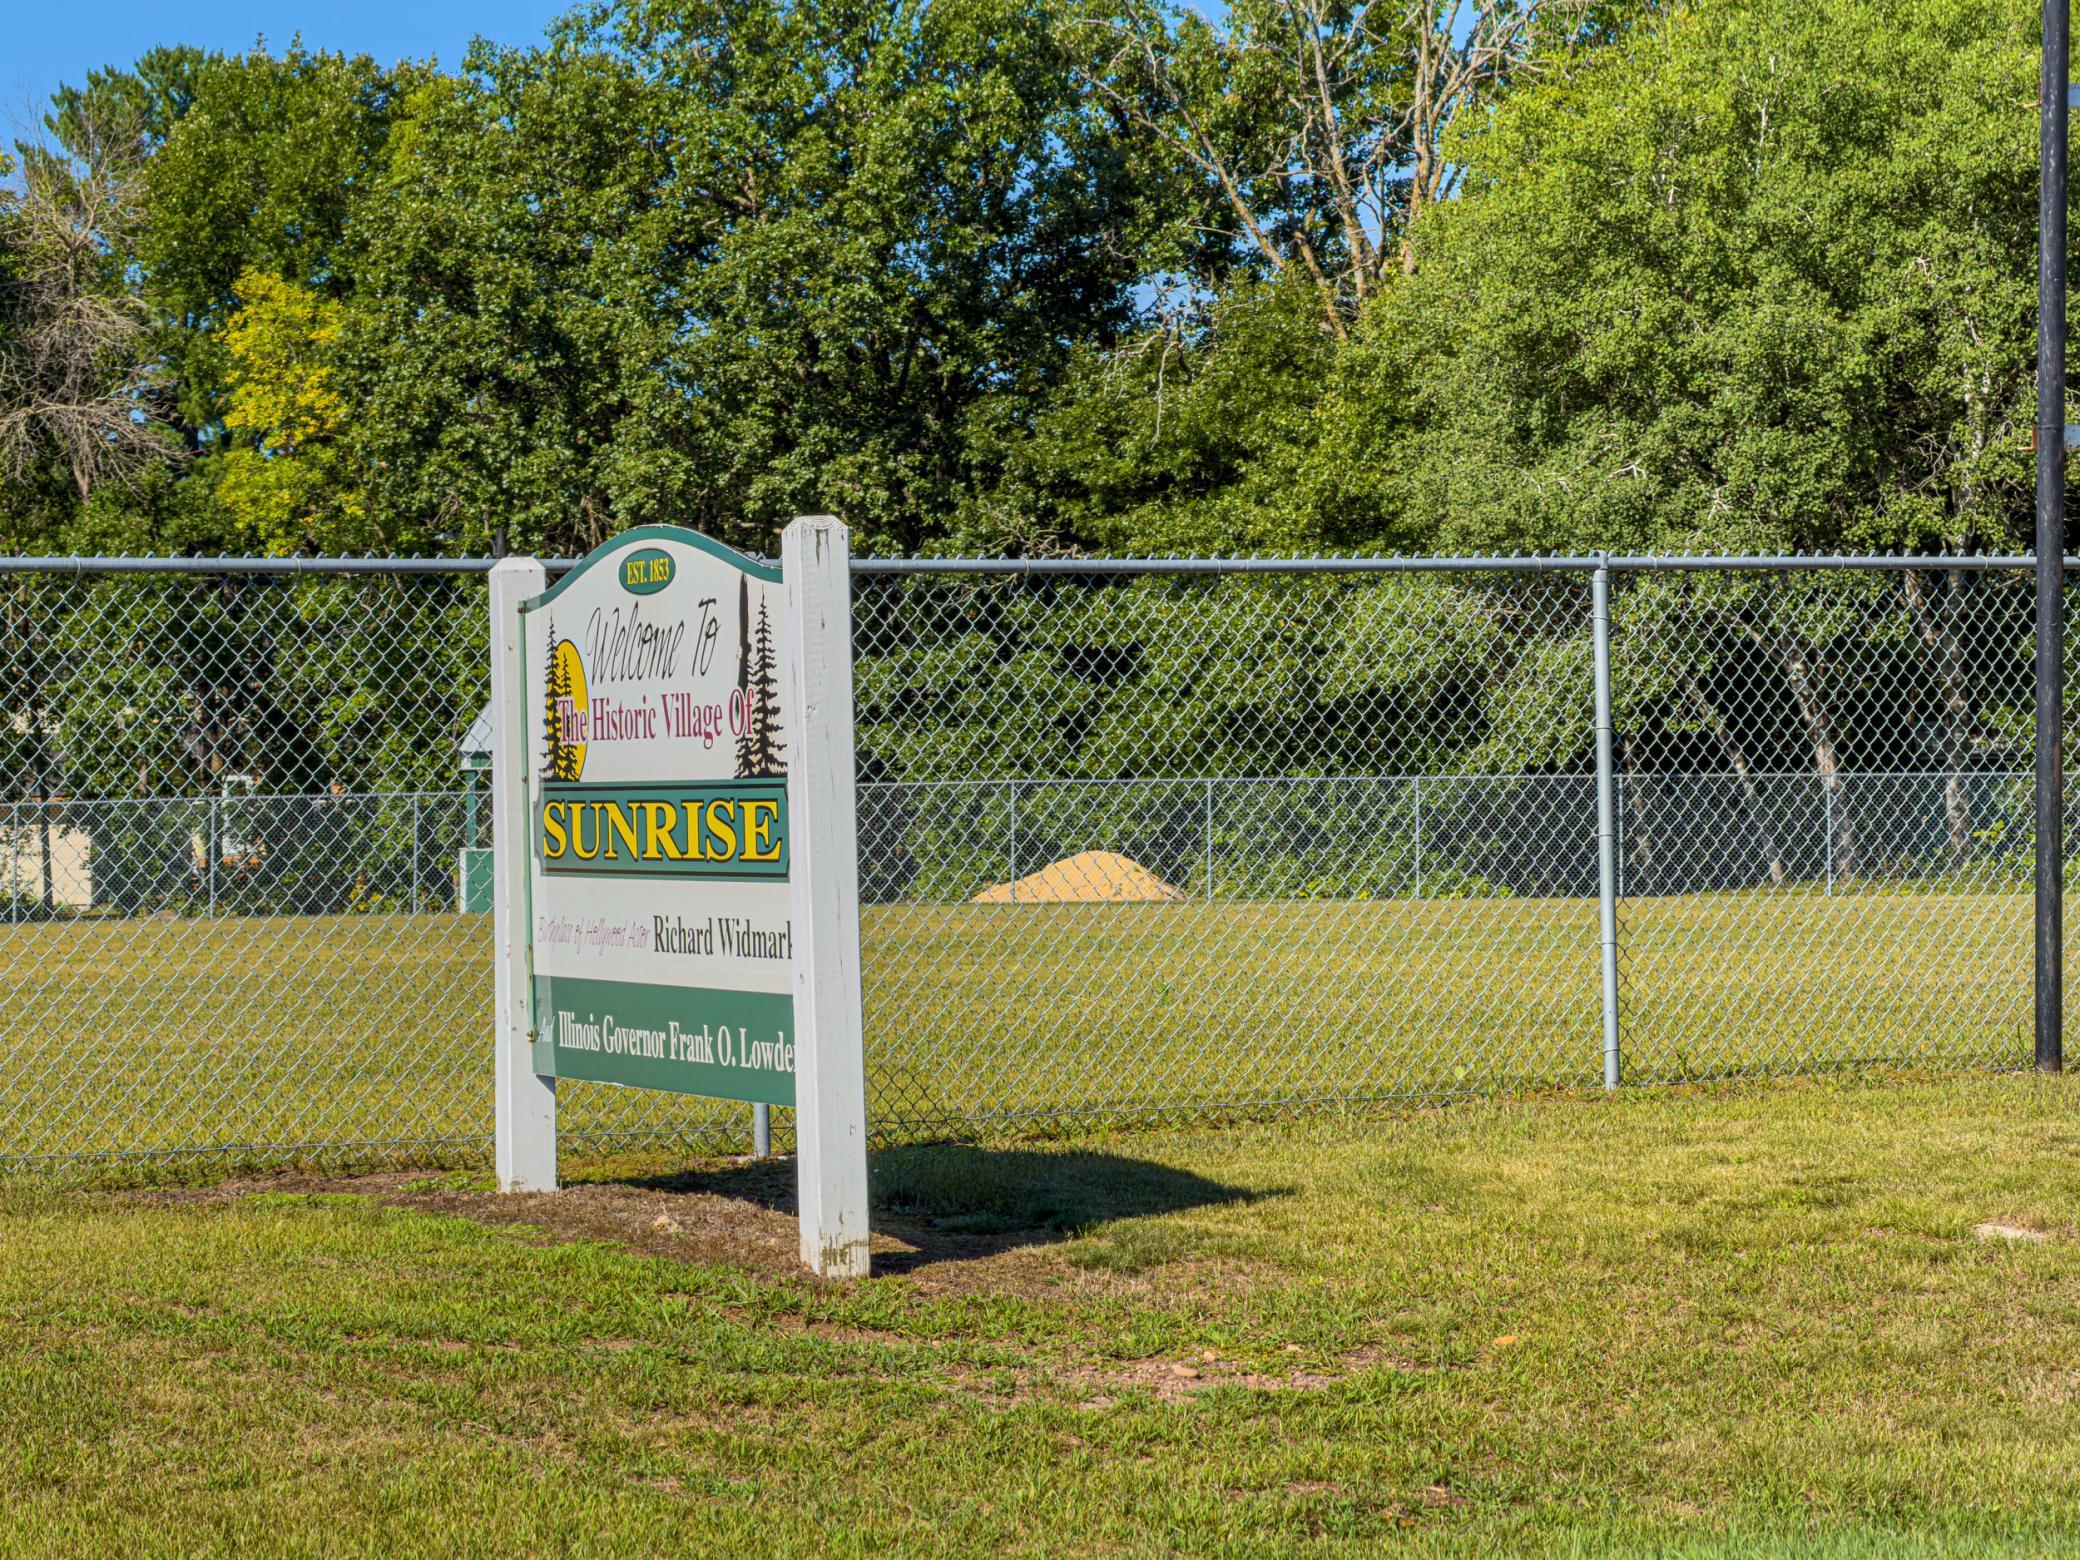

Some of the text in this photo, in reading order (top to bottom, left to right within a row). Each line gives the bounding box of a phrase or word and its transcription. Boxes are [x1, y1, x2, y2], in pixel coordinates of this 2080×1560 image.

[627, 557, 669, 585] EST. 1853
[585, 597, 721, 686] Welcome To
[557, 687, 755, 750] The Historic Village Of
[543, 797, 783, 863] SUNRISE
[653, 915, 713, 956] Richard
[558, 1010, 600, 1051] Illinois
[602, 1015, 666, 1059] Governor
[668, 1020, 715, 1063] Frank
[717, 1025, 736, 1068] O.
[738, 1027, 797, 1073] Lowde
